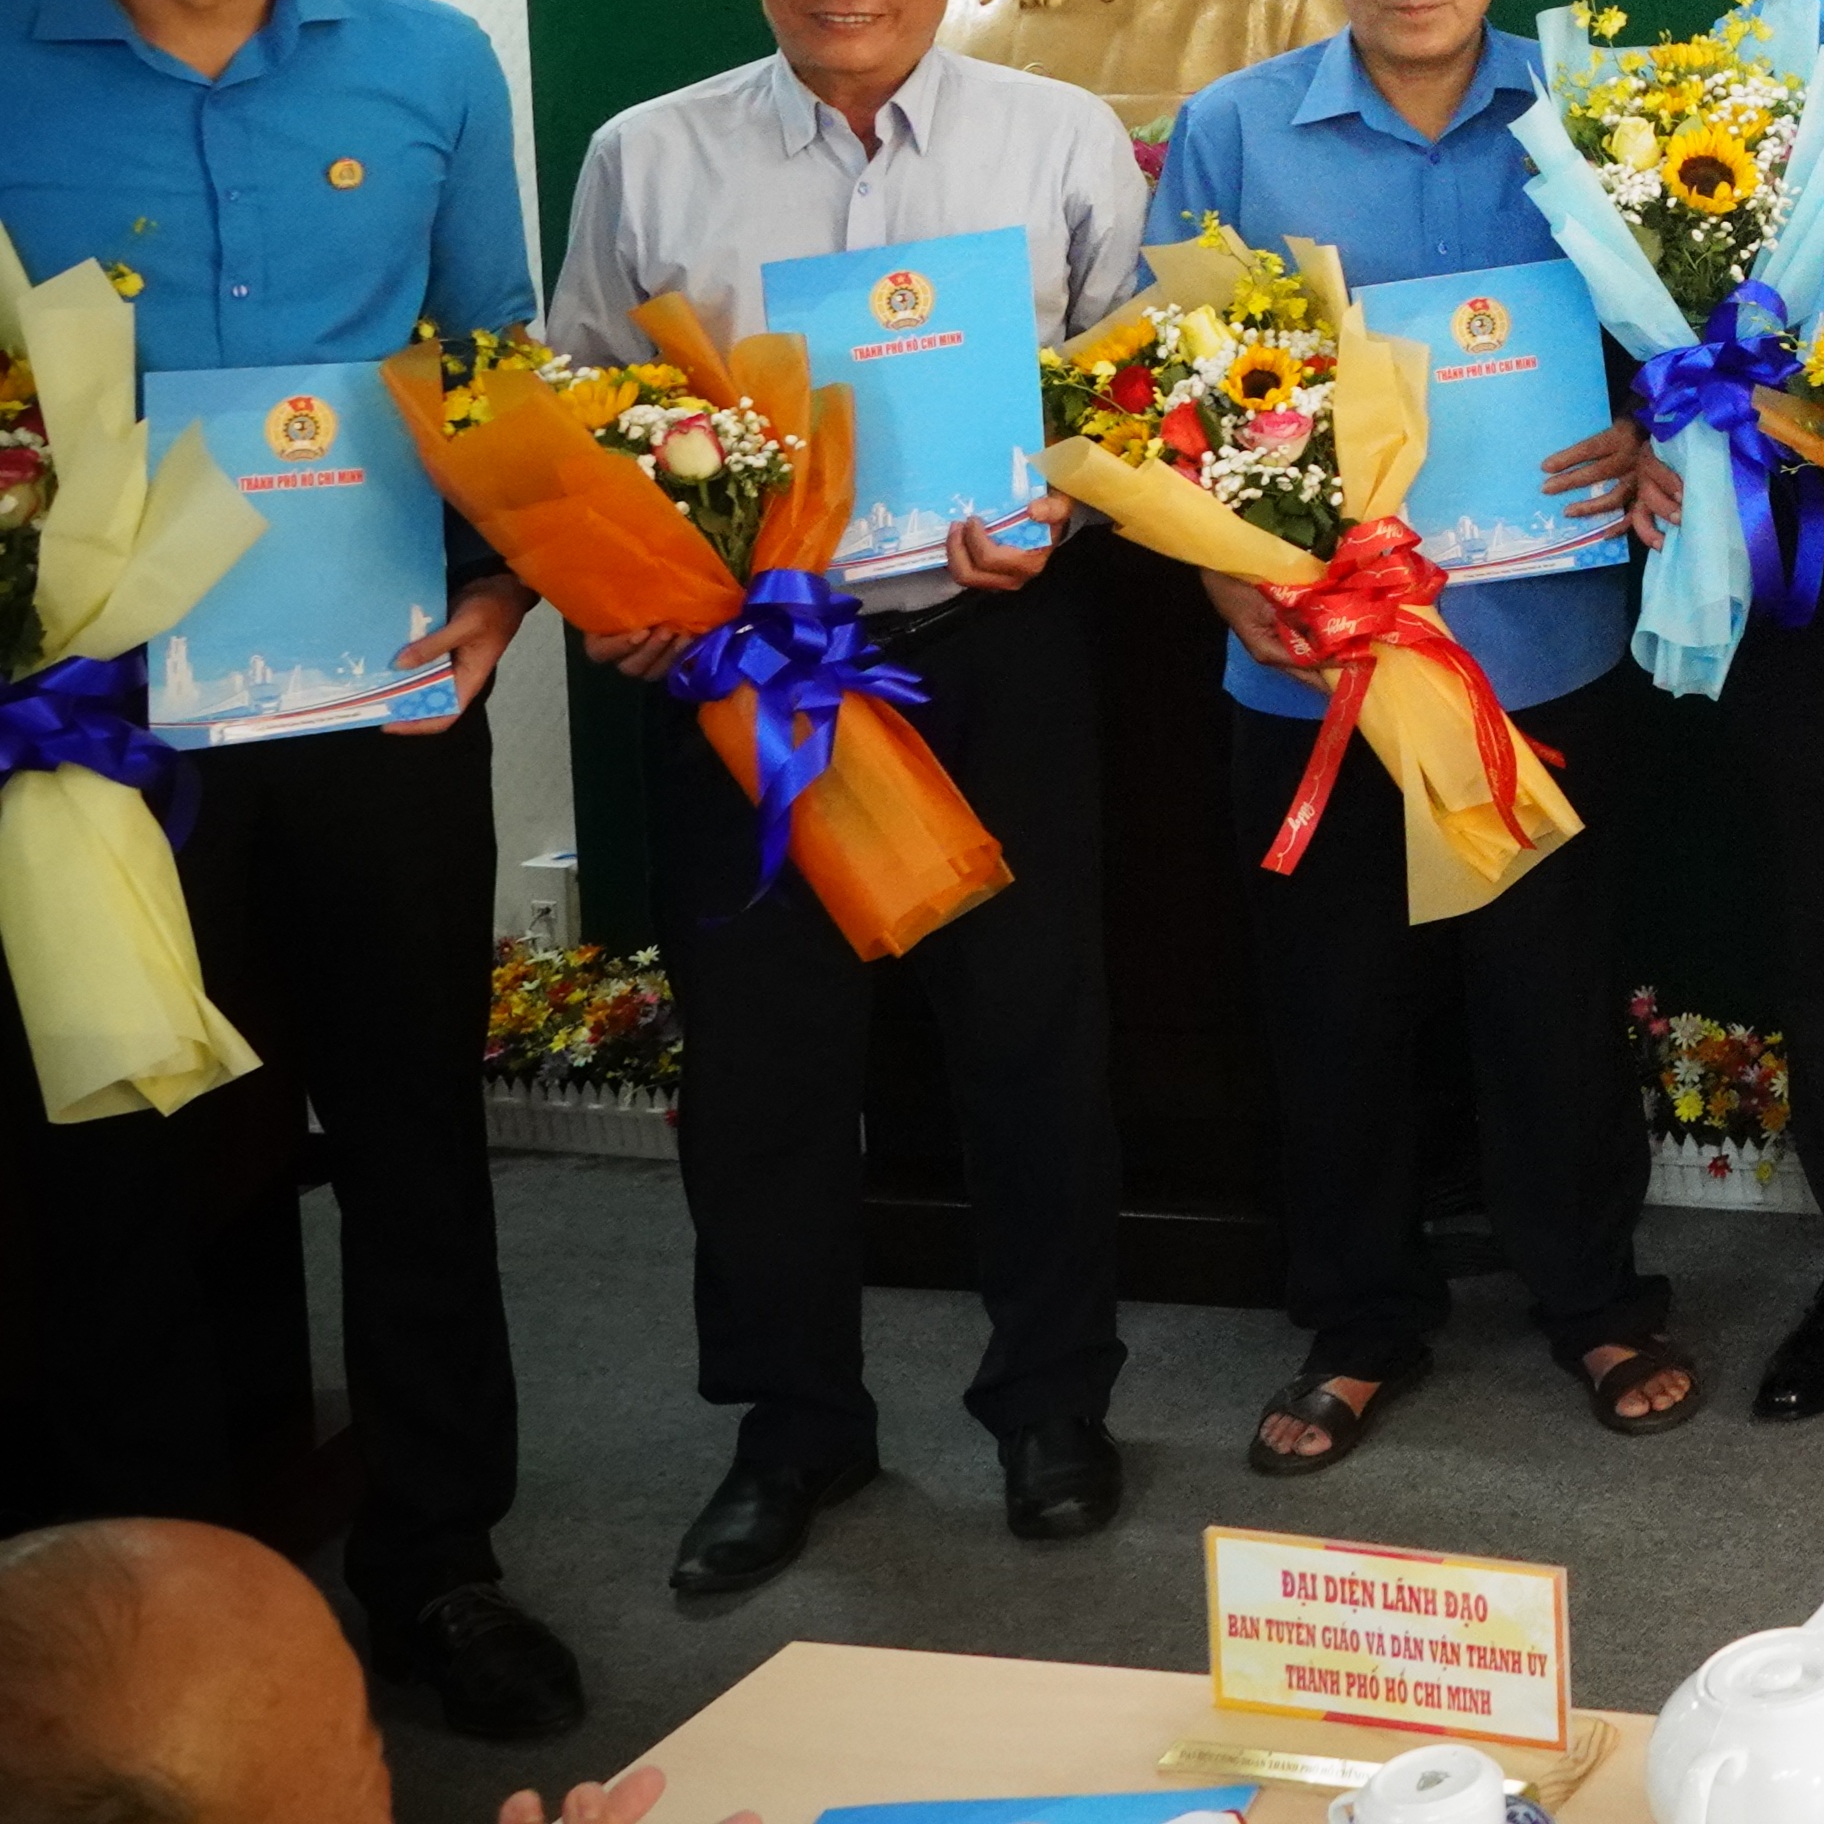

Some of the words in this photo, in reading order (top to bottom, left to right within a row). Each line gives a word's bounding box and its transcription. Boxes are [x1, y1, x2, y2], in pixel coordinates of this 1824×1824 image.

[1281, 1569, 1319, 1607] ĐẠI
[1324, 1572, 1375, 1614] DIỆN
[1444, 1589, 1489, 1628] ĐẠO
[1227, 1613, 1261, 1641] BAN
[1322, 1622, 1361, 1653] GIÁO
[1466, 1639, 1523, 1675] THÀNH
[1285, 1661, 1342, 1697] THÀNH
[1346, 1665, 1380, 1701] PHỐ
[1413, 1676, 1443, 1711] CHÍ
[1447, 1684, 1493, 1717] MINH
